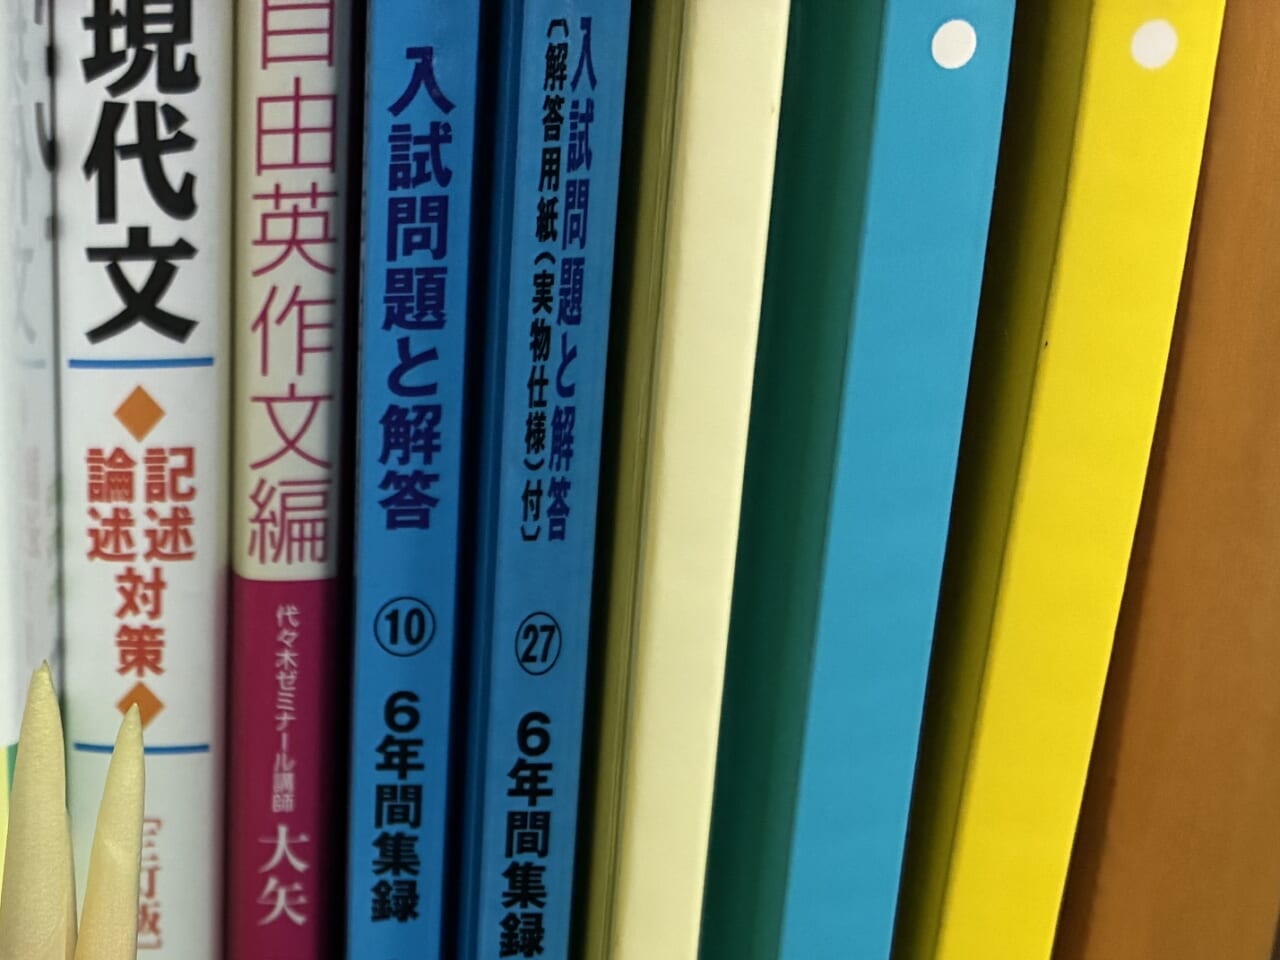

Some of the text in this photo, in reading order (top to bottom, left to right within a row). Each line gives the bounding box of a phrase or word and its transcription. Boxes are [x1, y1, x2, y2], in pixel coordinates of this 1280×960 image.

[81, 0, 201, 345] 現代文
[250, 0, 336, 565] 自由英作文編
[377, 46, 456, 531] 入試問題と解答
[546, 17, 597, 541] 入試問題と解答
[271, 603, 302, 813] 代々木ゼミナール講師
[371, 690, 425, 924] 6年間集録
[499, 711, 553, 958] 6年間集録
